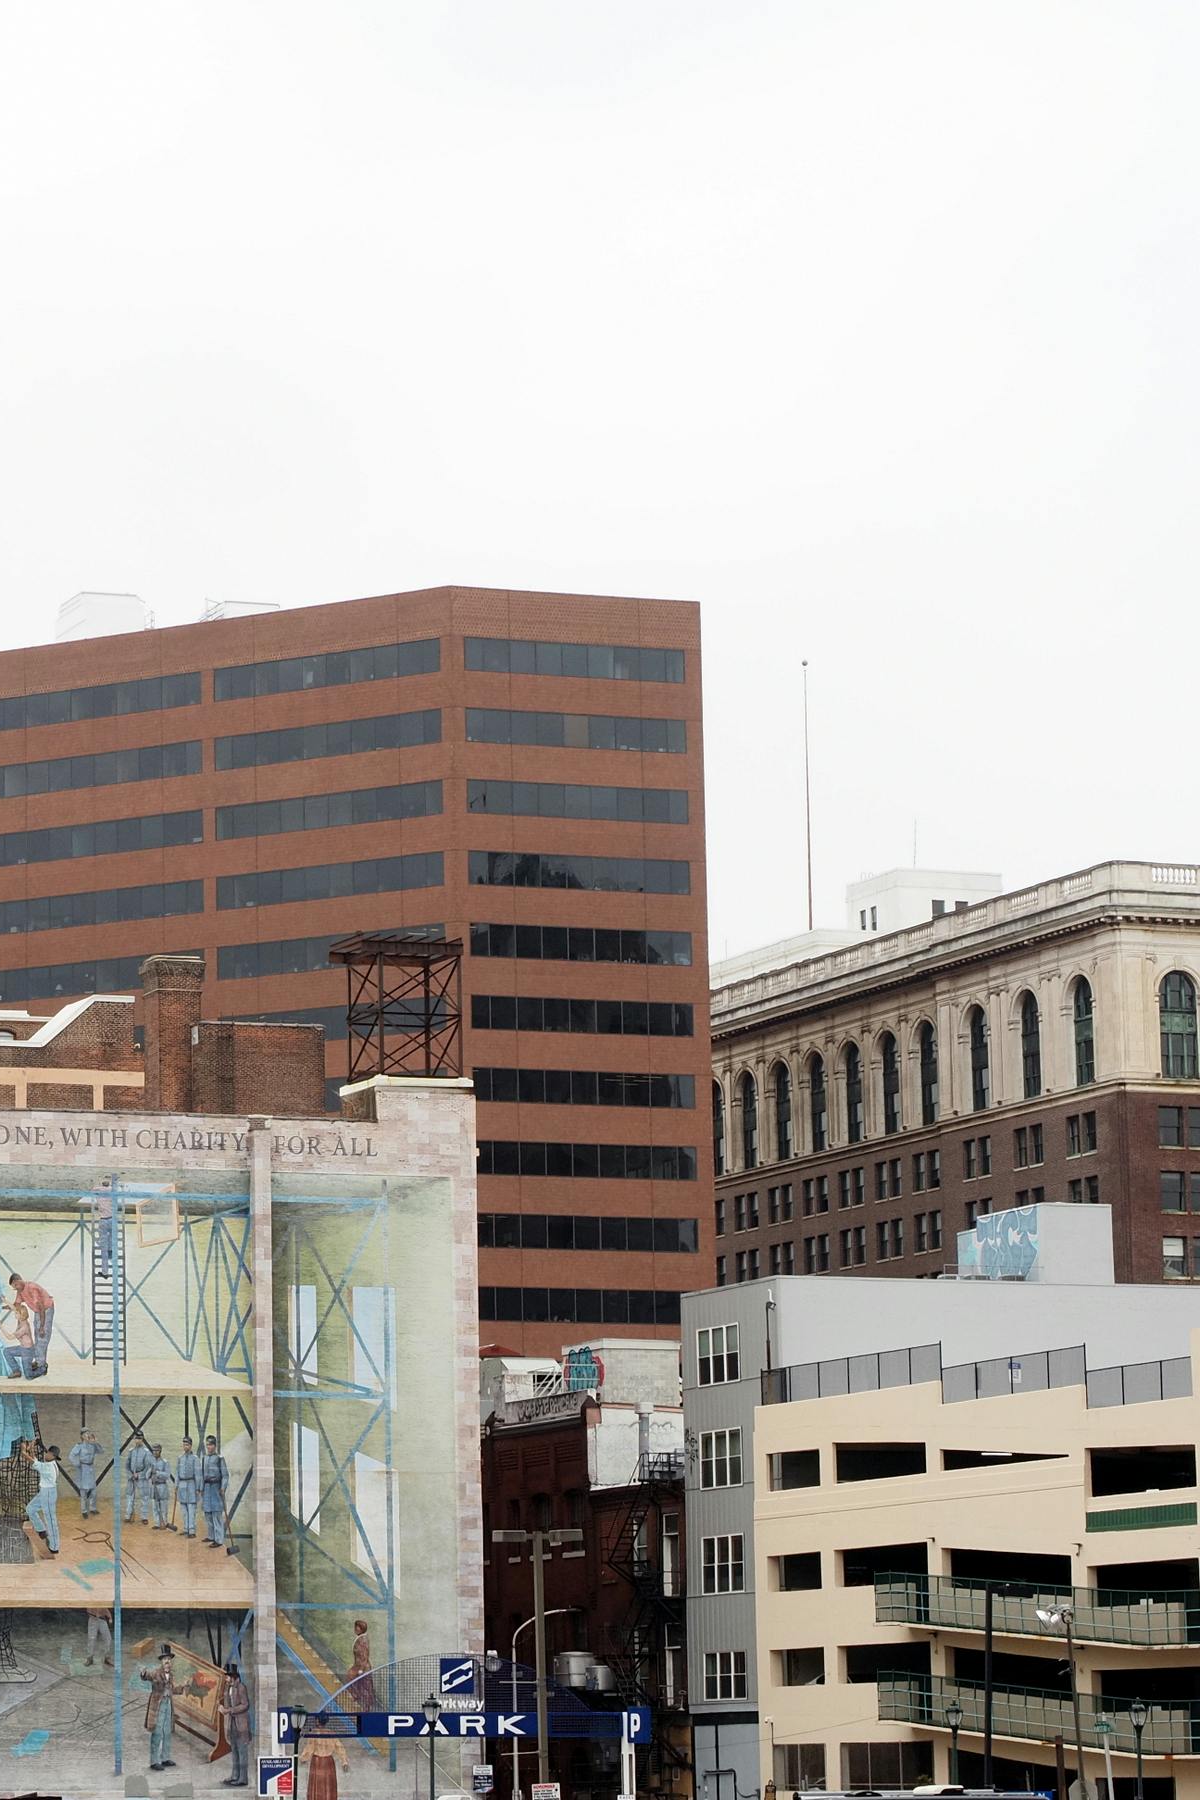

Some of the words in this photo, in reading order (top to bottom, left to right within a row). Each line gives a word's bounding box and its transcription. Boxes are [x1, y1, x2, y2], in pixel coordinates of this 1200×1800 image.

[60, 1127, 128, 1148] WITH
[136, 1129, 247, 1151] CHARITY
[274, 1135, 322, 1156] FOR
[332, 1136, 378, 1157] ALL
[438, 1699, 484, 1711] rkway
[280, 1713, 288, 1738] P
[388, 1715, 527, 1735] PARK
[631, 1713, 640, 1738] P
